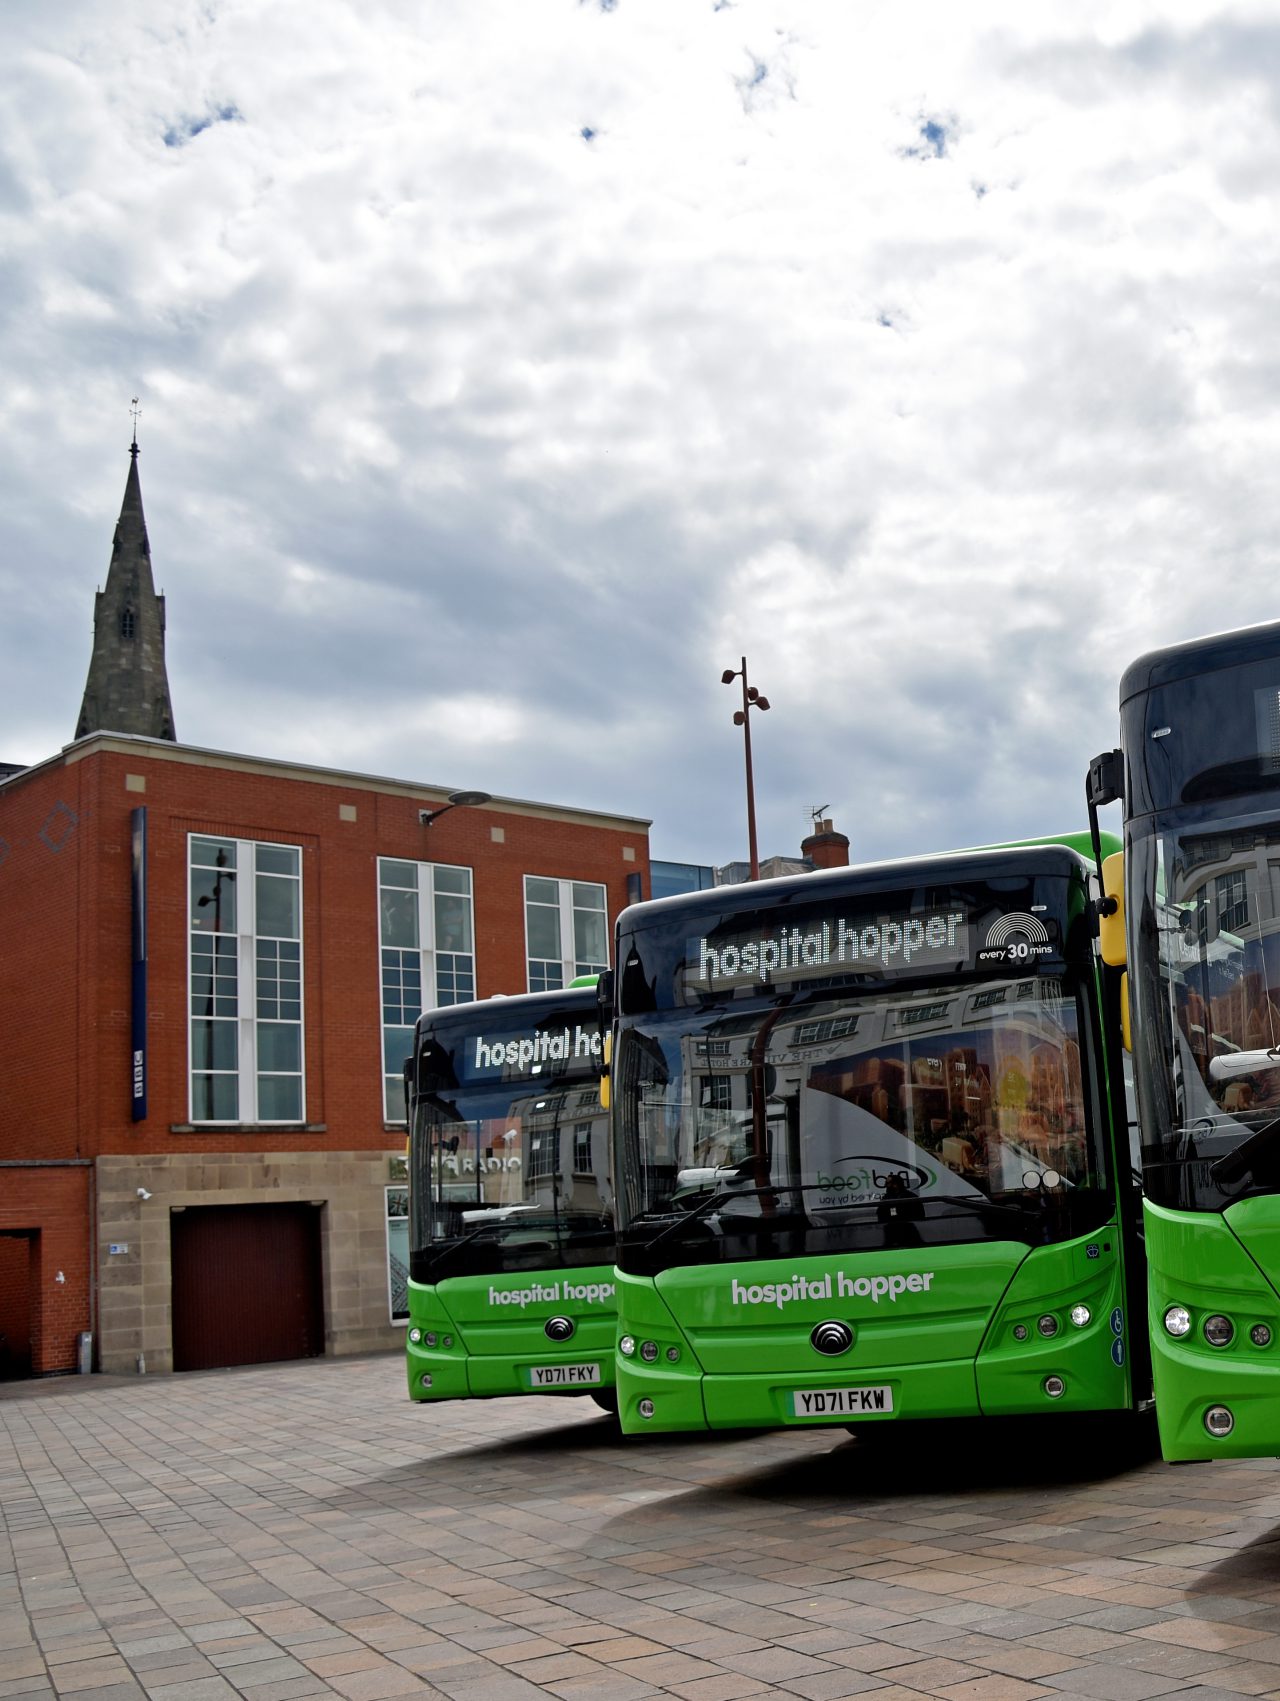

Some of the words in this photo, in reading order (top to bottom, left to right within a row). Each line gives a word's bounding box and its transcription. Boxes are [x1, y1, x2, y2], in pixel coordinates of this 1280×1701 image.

[700, 921, 830, 982] hospital
[838, 913, 964, 966] hopper
[980, 950, 1006, 960] every
[1007, 943, 1028, 959] 30
[1029, 944, 1053, 955] mins
[475, 1026, 571, 1071] hospital
[574, 1025, 611, 1057] ho
[134, 1050, 143, 1098] BBC
[489, 1282, 560, 1309] hospital
[563, 1280, 616, 1304] hopp
[732, 1273, 833, 1310] hospital
[837, 1271, 935, 1304] hopper
[536, 1367, 566, 1383] YD71
[568, 1366, 595, 1381] FKY
[801, 1391, 844, 1413] YD71
[848, 1389, 884, 1411] FKW
